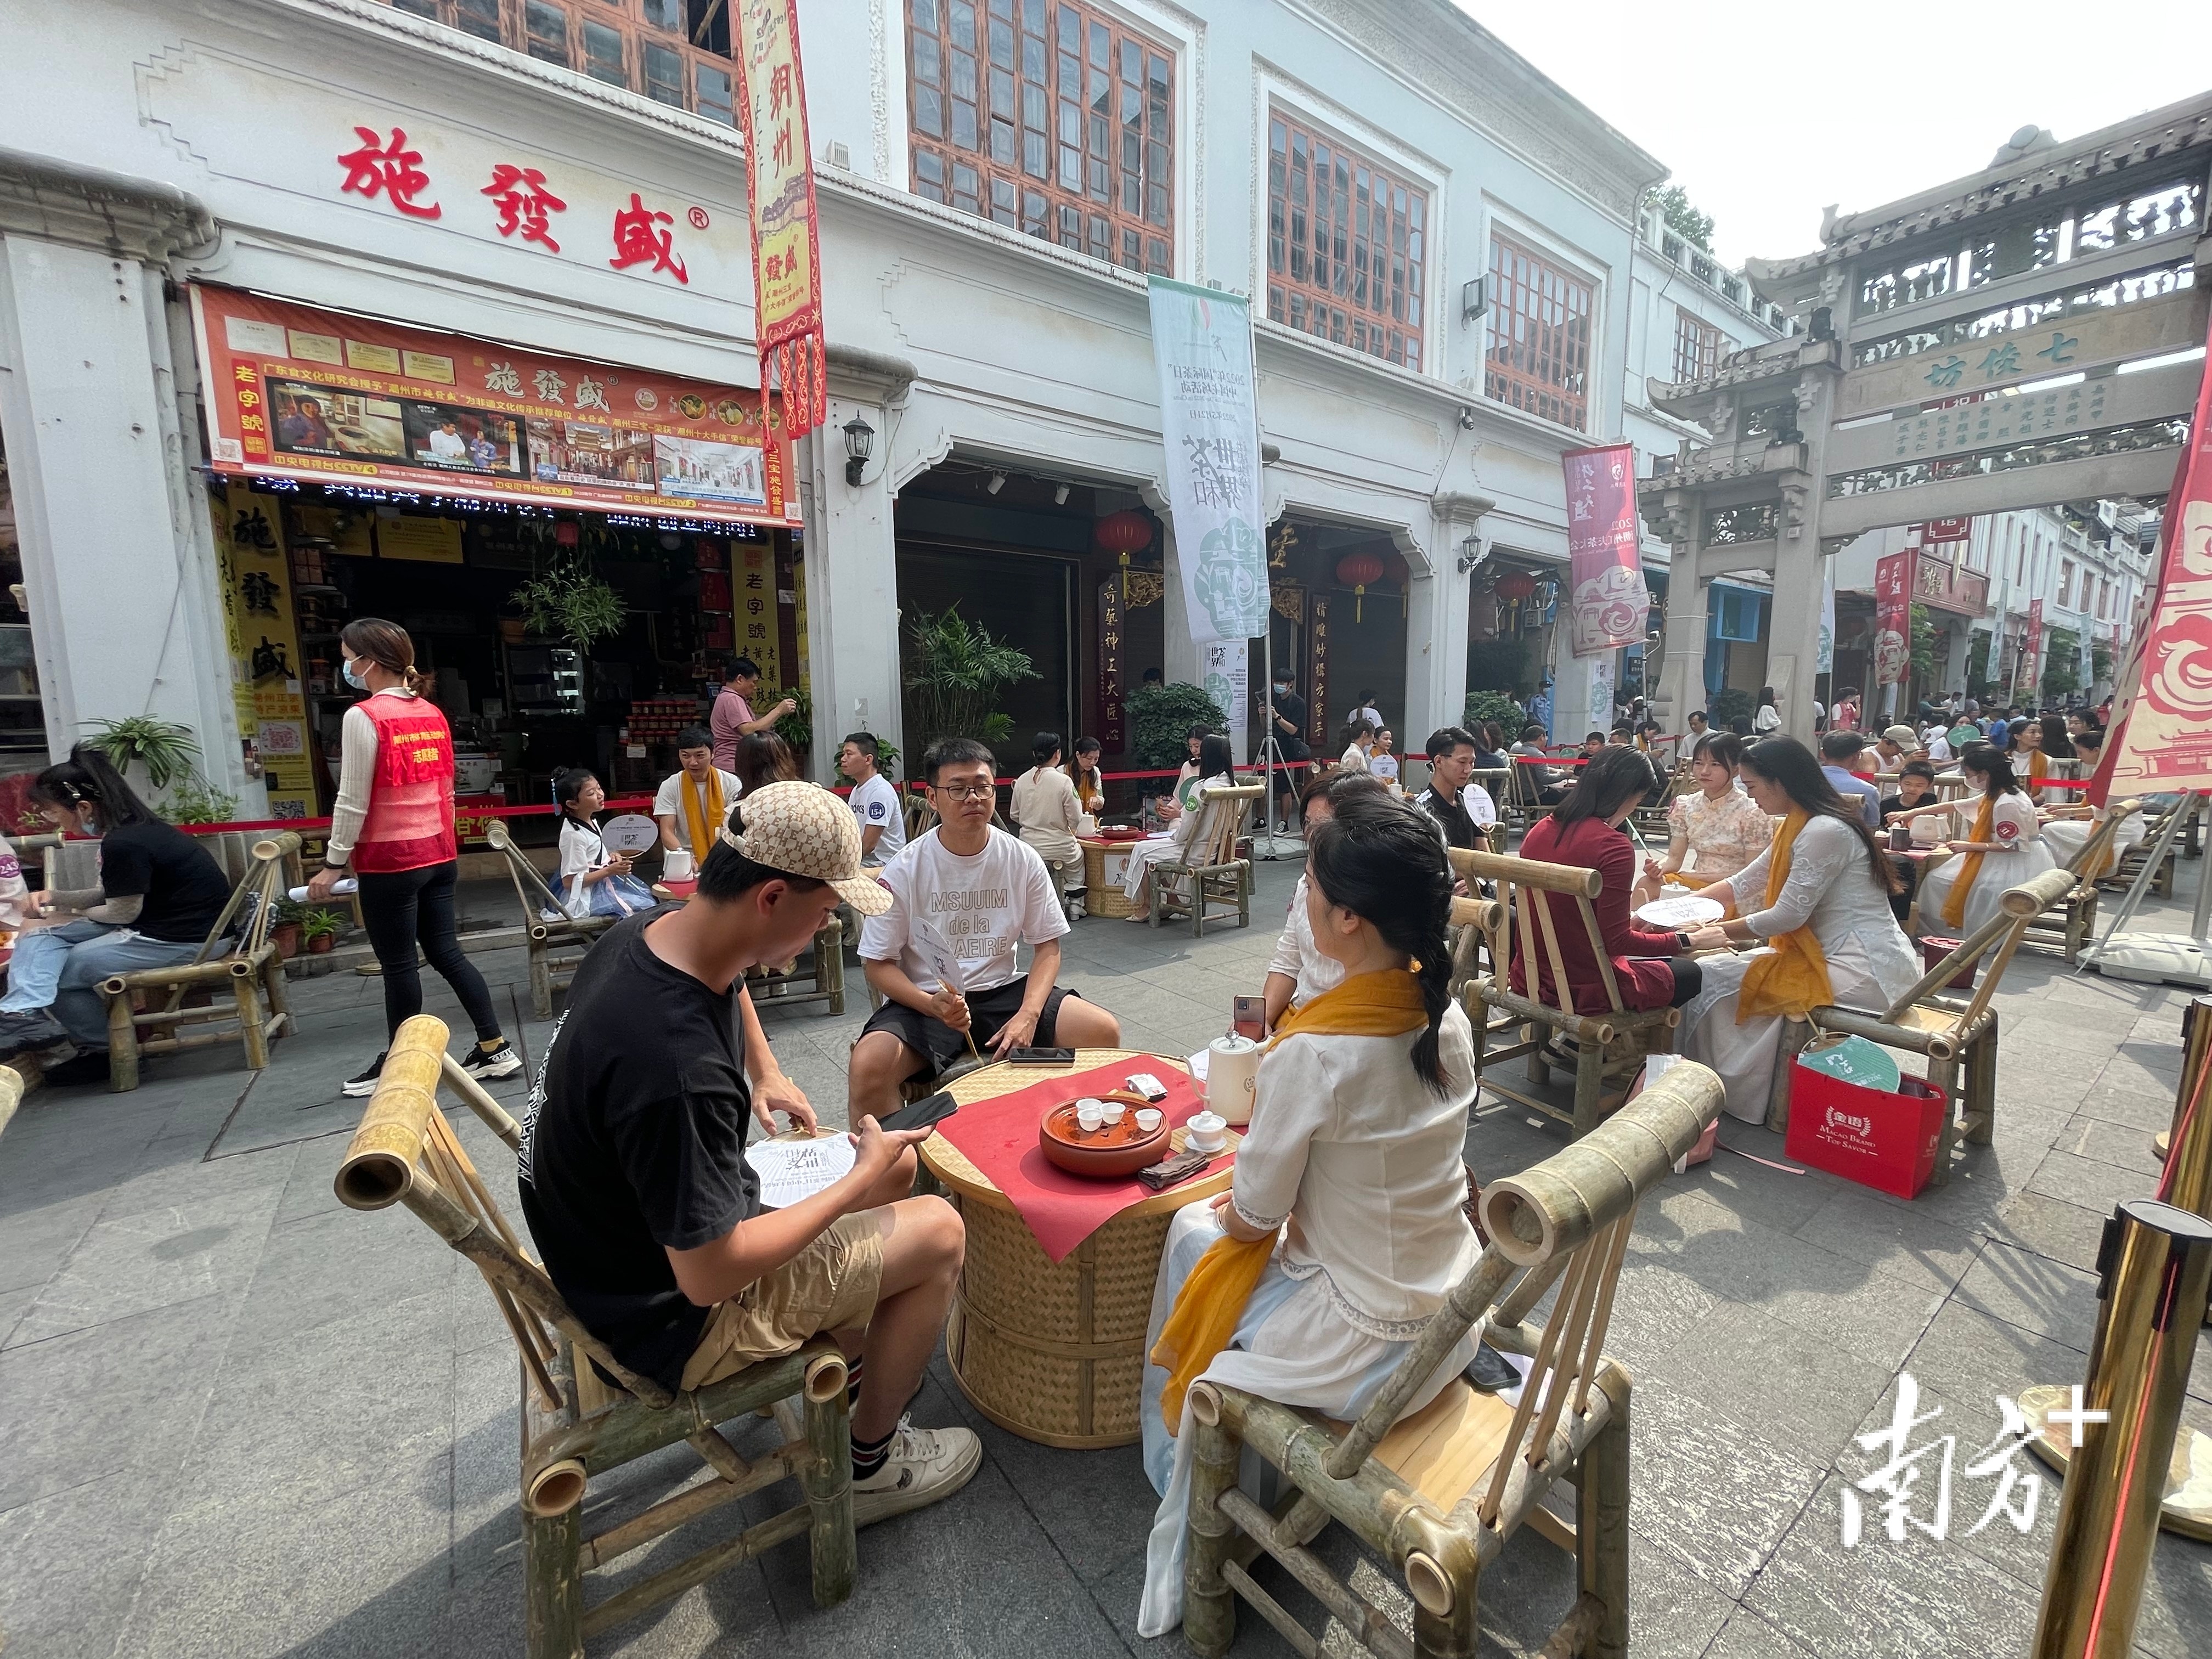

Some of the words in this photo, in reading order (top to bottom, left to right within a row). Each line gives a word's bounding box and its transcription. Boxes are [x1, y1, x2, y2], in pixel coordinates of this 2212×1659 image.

[337, 126, 689, 285] 施發盛
[1923, 332, 2079, 388] 七俊坊
[235, 365, 264, 432] 老字號
[484, 362, 611, 414] 施發盛
[234, 506, 296, 680] 施發盛
[746, 572, 766, 640] 老字號
[413, 747, 439, 763] 志愿者
[932, 888, 1007, 912] MSUUIM
[949, 916, 969, 935] de
[974, 915, 990, 933] la
[948, 936, 1007, 959] AEIRE
